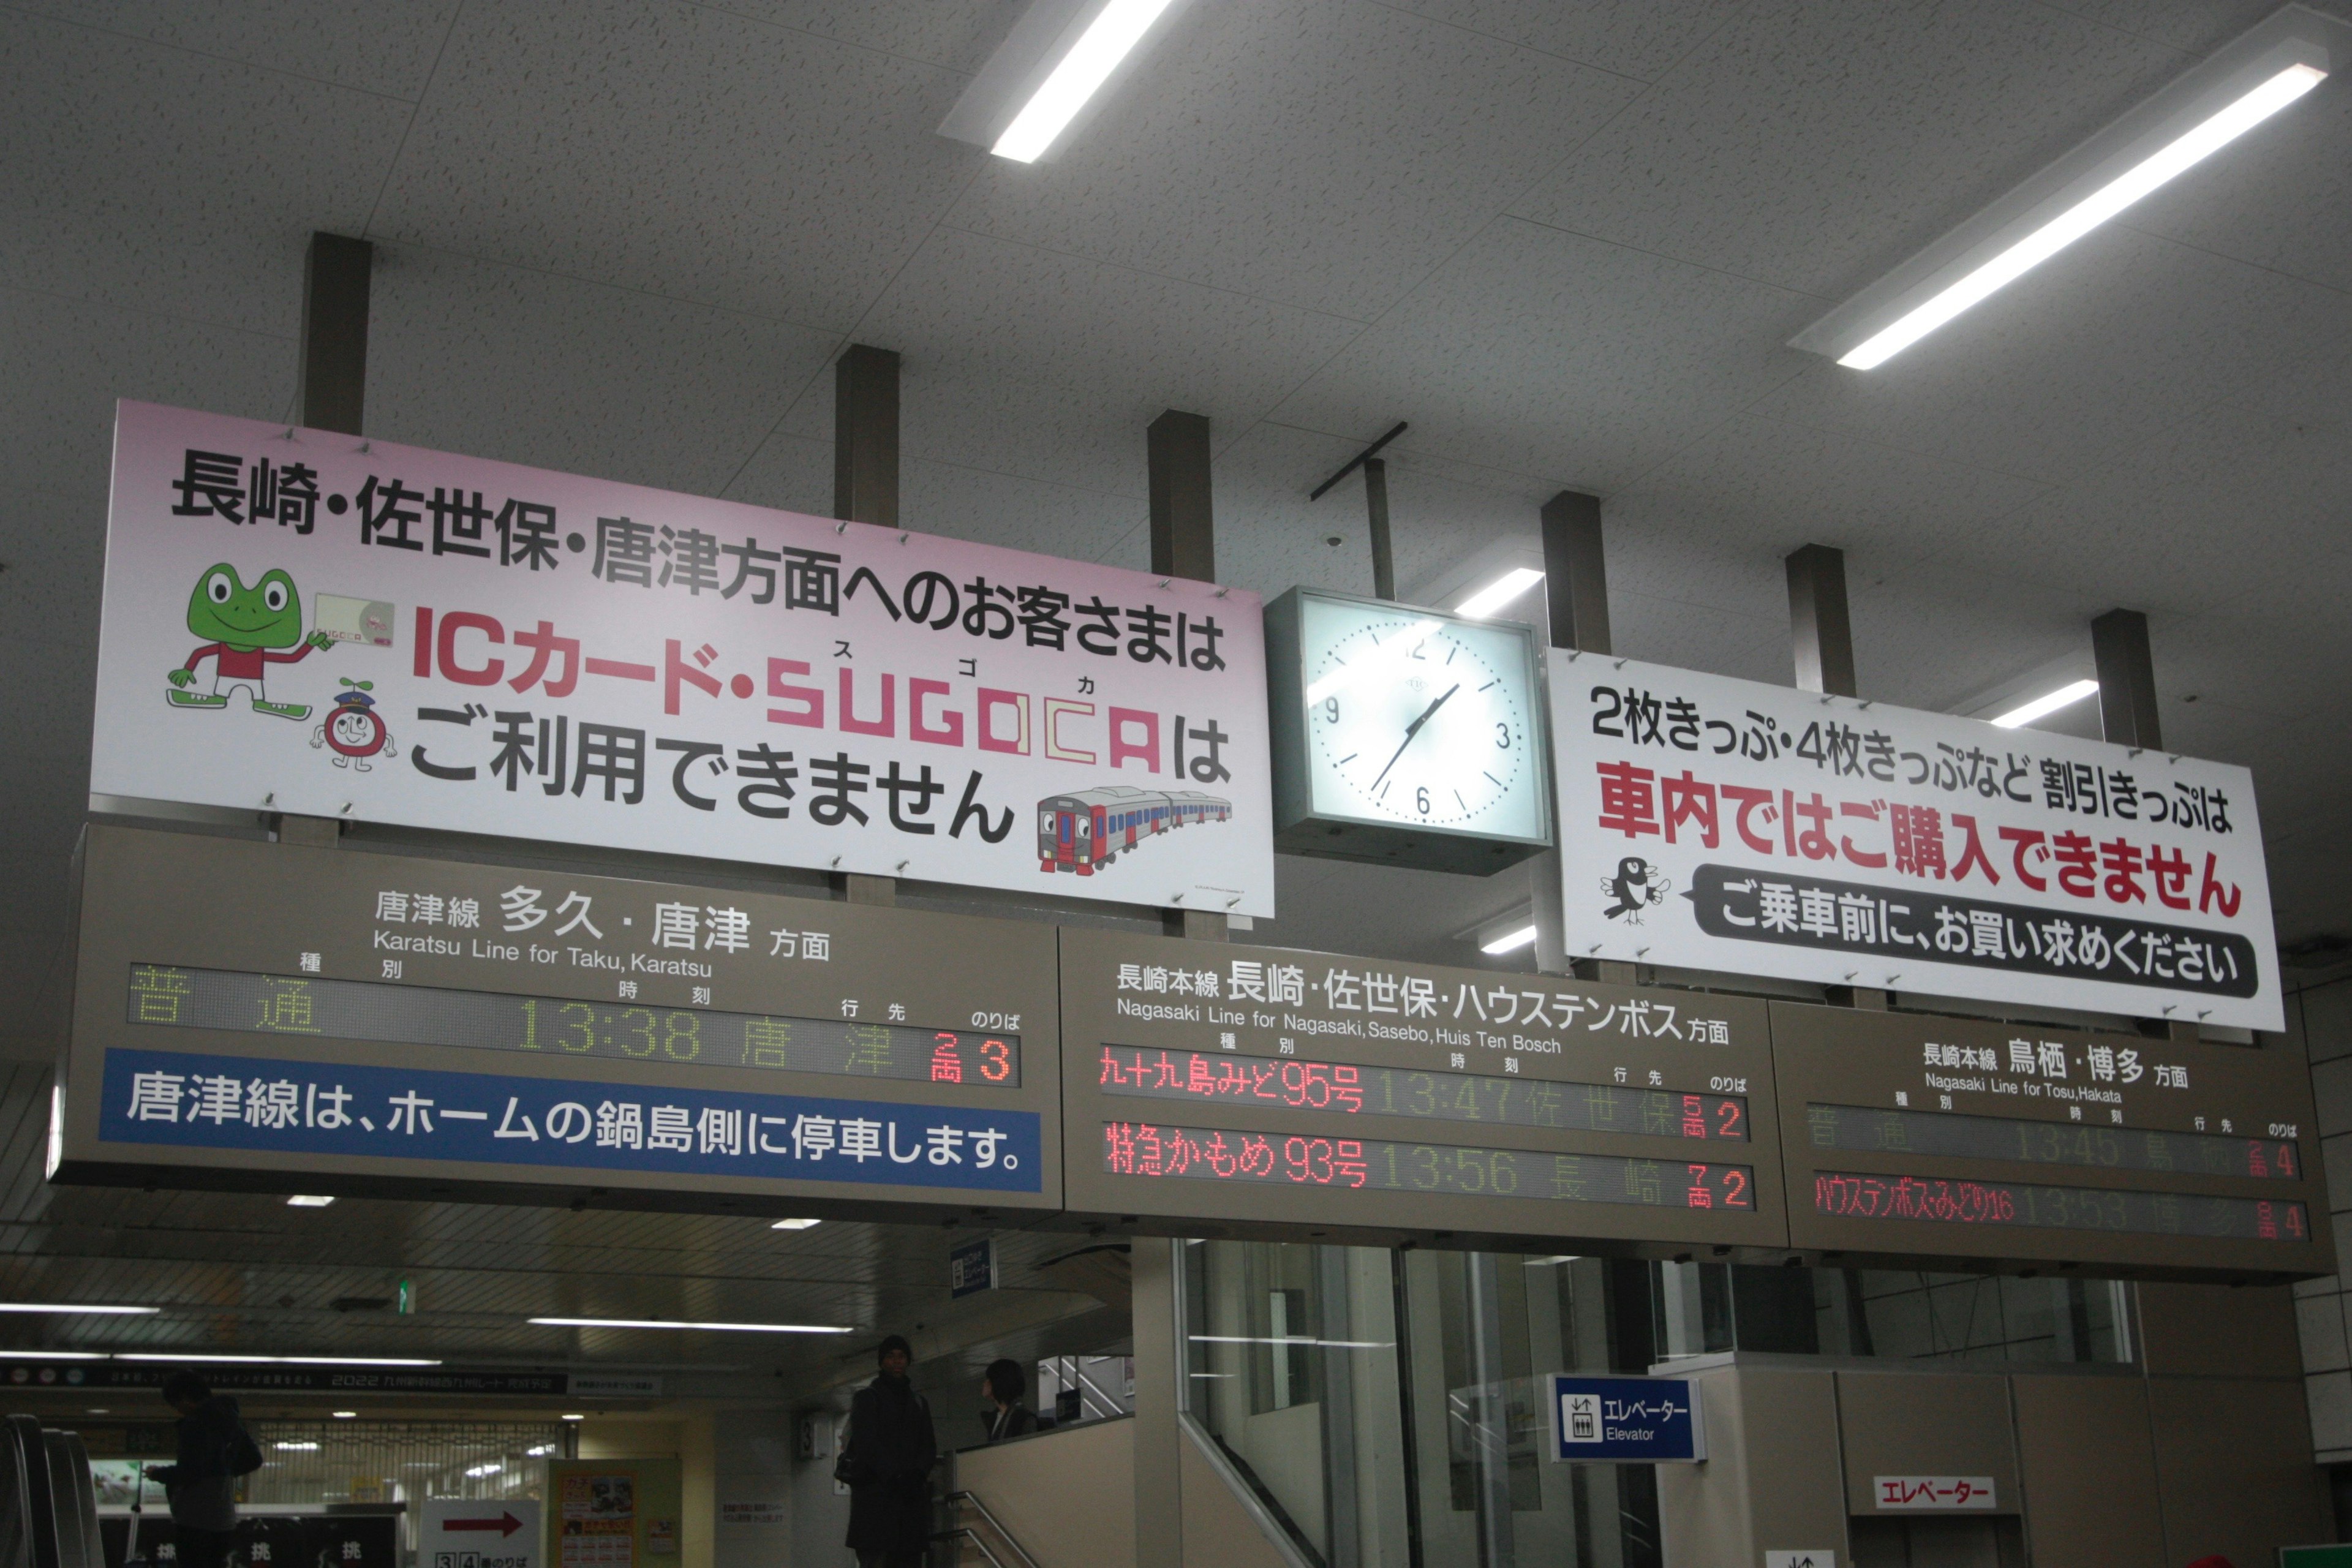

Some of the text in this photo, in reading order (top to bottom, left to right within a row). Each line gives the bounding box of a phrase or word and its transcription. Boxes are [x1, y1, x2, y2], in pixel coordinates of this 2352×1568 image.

[172, 449, 1226, 671] 長崎・佐世保・唐津方面へのお客さまは
[834, 640, 1095, 695] ス ゴ カ
[413, 606, 1231, 784] ICカード・SUGOCAは
[1325, 696, 1339, 723] 9
[1496, 723, 1510, 749] 3
[1591, 685, 2233, 833] 2枚きっぷ・4枚きっぷなど 割引きっぷは
[410, 703, 1014, 843] ご利用できません
[1417, 786, 1430, 814] 6
[1596, 761, 2242, 918] 車内ではご購入できません
[375, 884, 831, 962] 唐津線 多久・唐津 方面
[1722, 879, 2238, 982] ご乗車前に、お買い求めください
[374, 930, 712, 978] Karatsu Line for Taku, Karatsu
[971, 1010, 1020, 1031] のりば
[1117, 960, 1730, 1046] 長崎本線 長崎・佐世保・ハウステンボス 方面
[1117, 998, 1199, 1022] Nagasaki
[1208, 1006, 1245, 1026] Line
[1253, 1010, 1276, 1028] for
[1436, 1028, 1471, 1046] Huis
[1476, 1031, 1506, 1049] Ten
[1513, 1035, 1561, 1054] Bosch
[519, 1000, 700, 1061] 13:38
[980, 1041, 1009, 1081] 3
[1924, 1038, 2188, 1090] 長崎本線 鳥栖・博多 方面
[1380, 1071, 1511, 1120] 13:47
[1717, 1101, 1740, 1137] 2
[1710, 1076, 1747, 1092] のりば
[1925, 1072, 1985, 1091] Nagasaki
[1991, 1077, 2018, 1094] Line
[2024, 1081, 2040, 1096] for
[127, 1070, 1018, 1170] 唐津線は、ホームの鍋島側に停車します。
[2269, 1123, 2297, 1137] のりば
[2015, 1121, 2120, 1164] 13:45
[2277, 1145, 2293, 1175] 4
[1383, 1144, 1517, 1194] 13:56
[1723, 1170, 1747, 1207] 2
[2286, 1207, 2302, 1238] 4
[332, 1374, 378, 1386] 2022
[1605, 1400, 1687, 1422] エレベーター
[1607, 1427, 1654, 1441] Elevator
[1882, 1481, 1989, 1504] エレベーター
[252, 1542, 271, 1561] 挑
[341, 1541, 361, 1559] 挑
